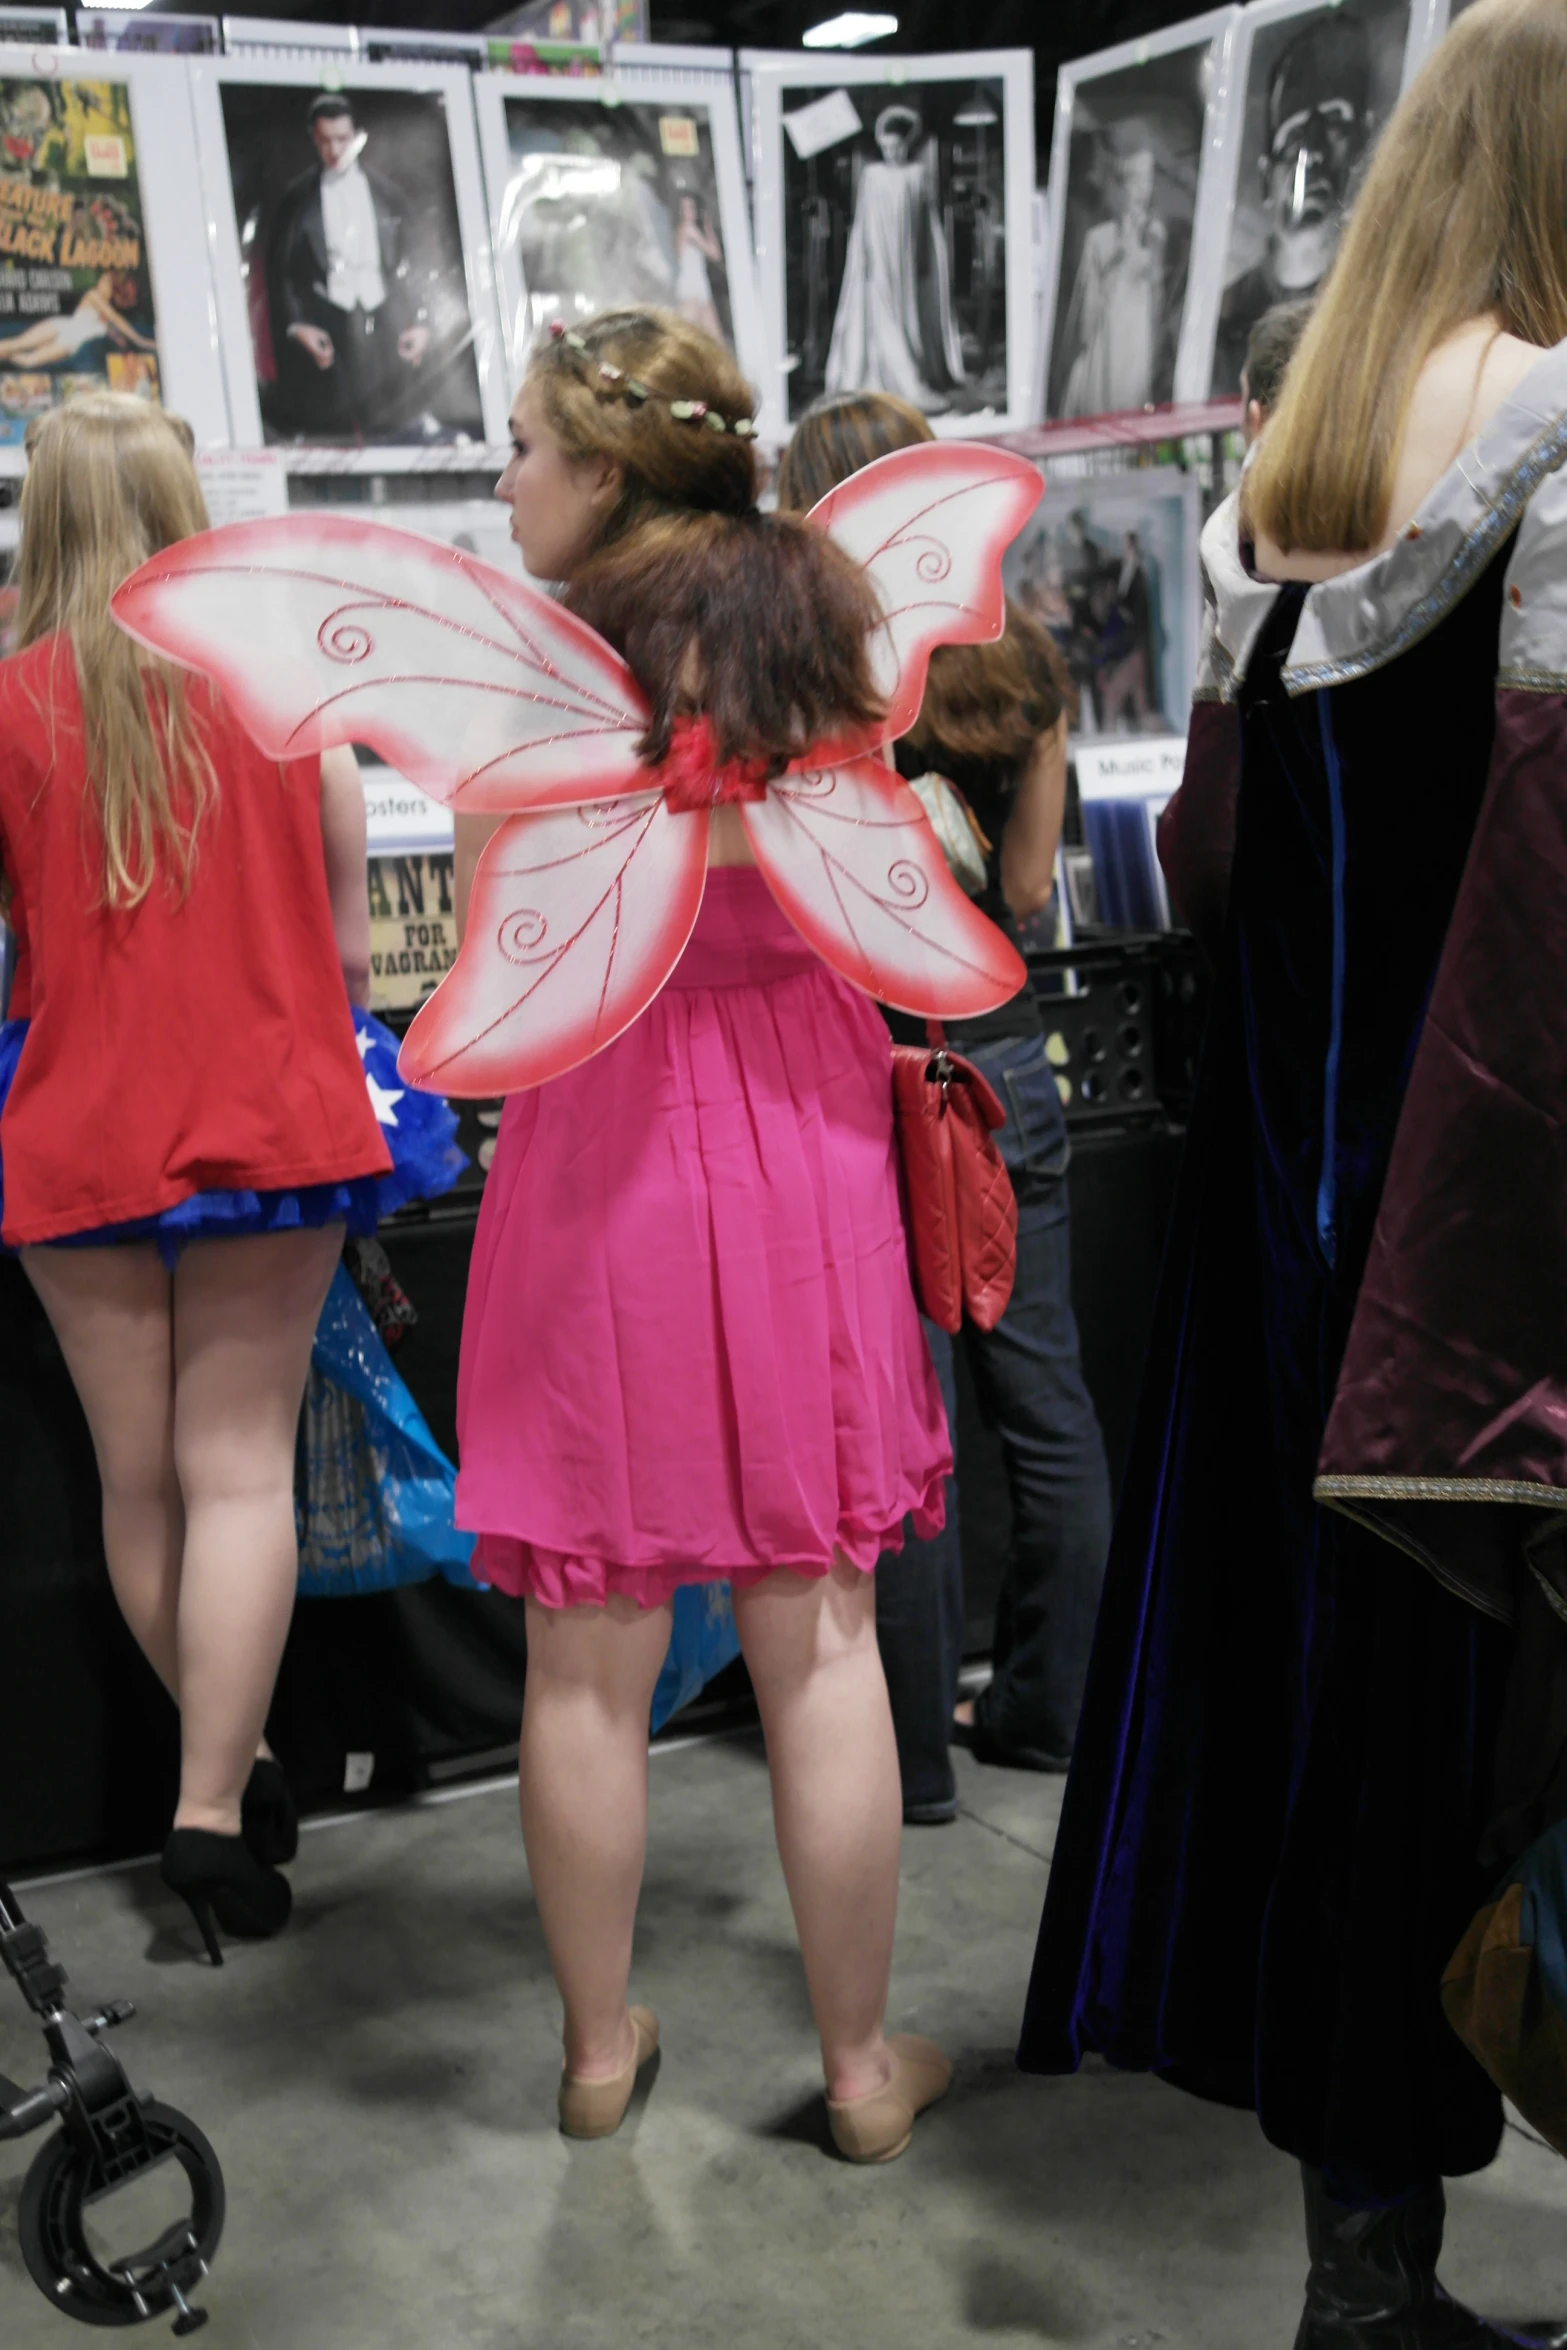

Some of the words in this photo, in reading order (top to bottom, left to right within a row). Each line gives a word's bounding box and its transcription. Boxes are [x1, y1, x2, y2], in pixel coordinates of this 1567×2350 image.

[0, 216, 57, 263] LACK
[60, 229, 139, 268] LAGOON
[1098, 758, 1153, 776] Music
[405, 923, 446, 947] FOR
[371, 948, 457, 977] VAGRAN
